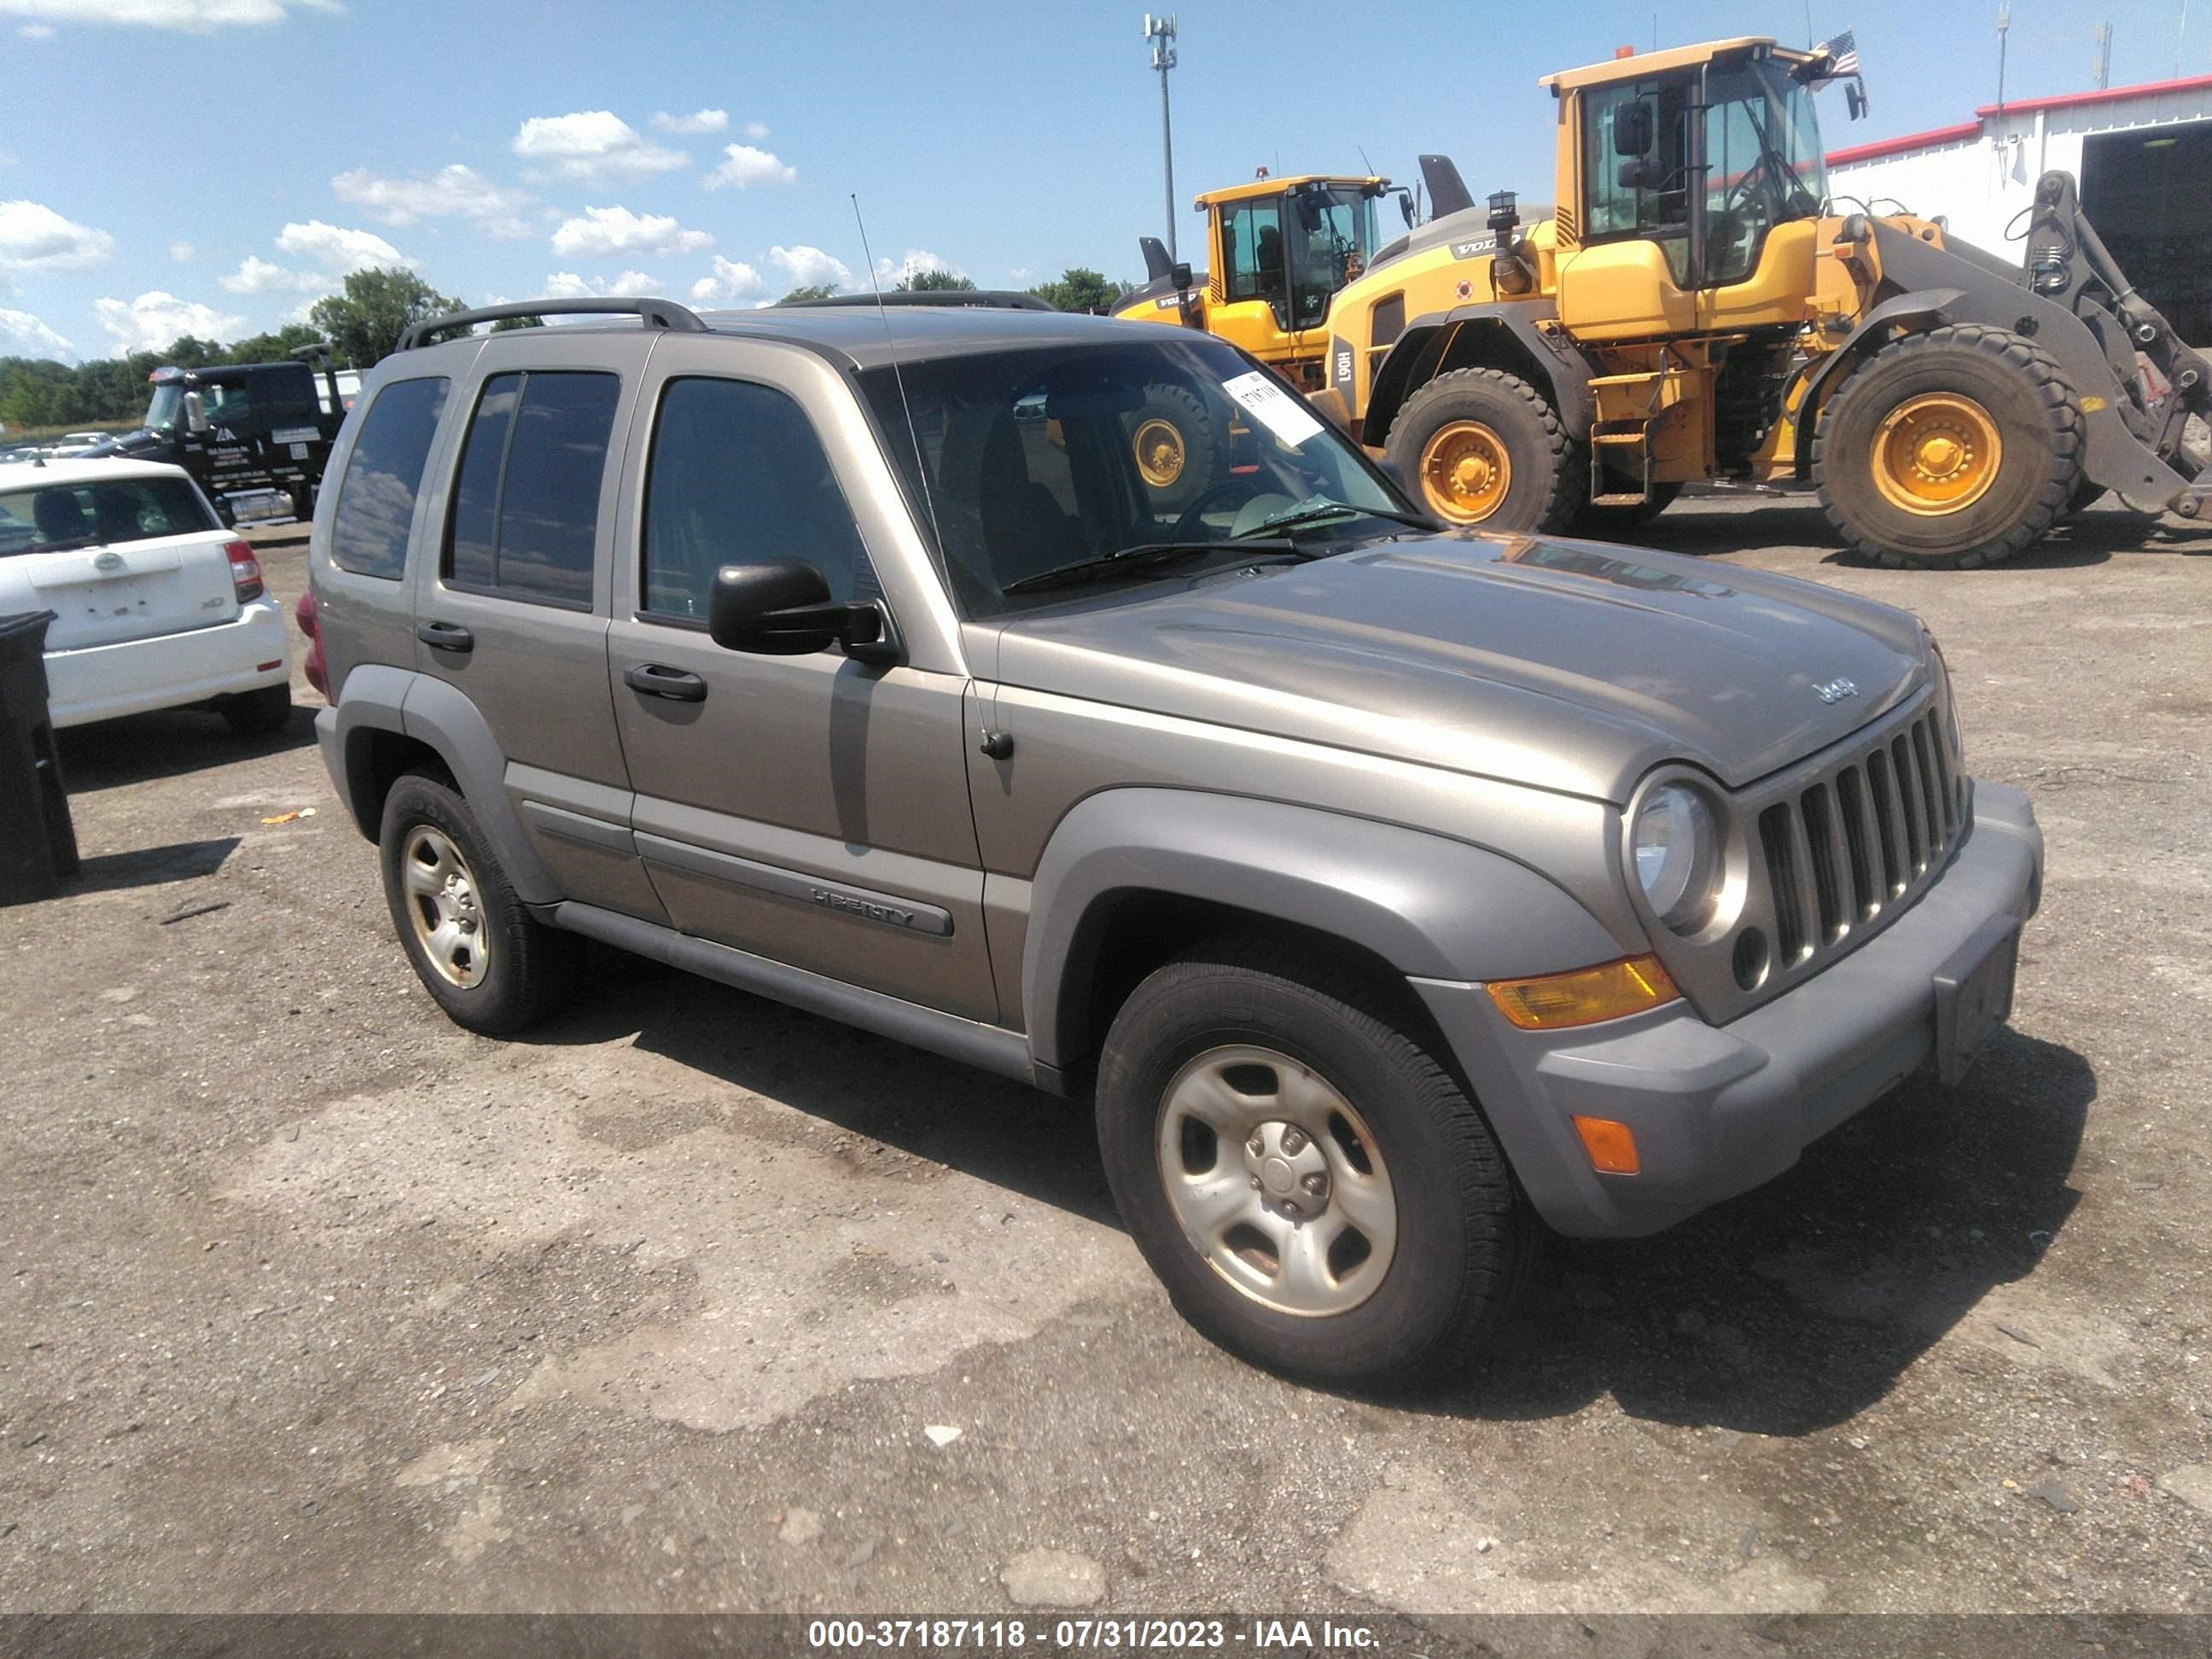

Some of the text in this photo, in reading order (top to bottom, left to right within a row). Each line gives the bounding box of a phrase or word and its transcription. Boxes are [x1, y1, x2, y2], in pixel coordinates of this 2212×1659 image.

[1458, 235, 1521, 254] VOLO
[1160, 293, 1196, 306] VOLO
[1337, 352, 1351, 382] L90H
[1812, 677, 1860, 705] Jeep
[811, 888, 914, 925] LIBERTY
